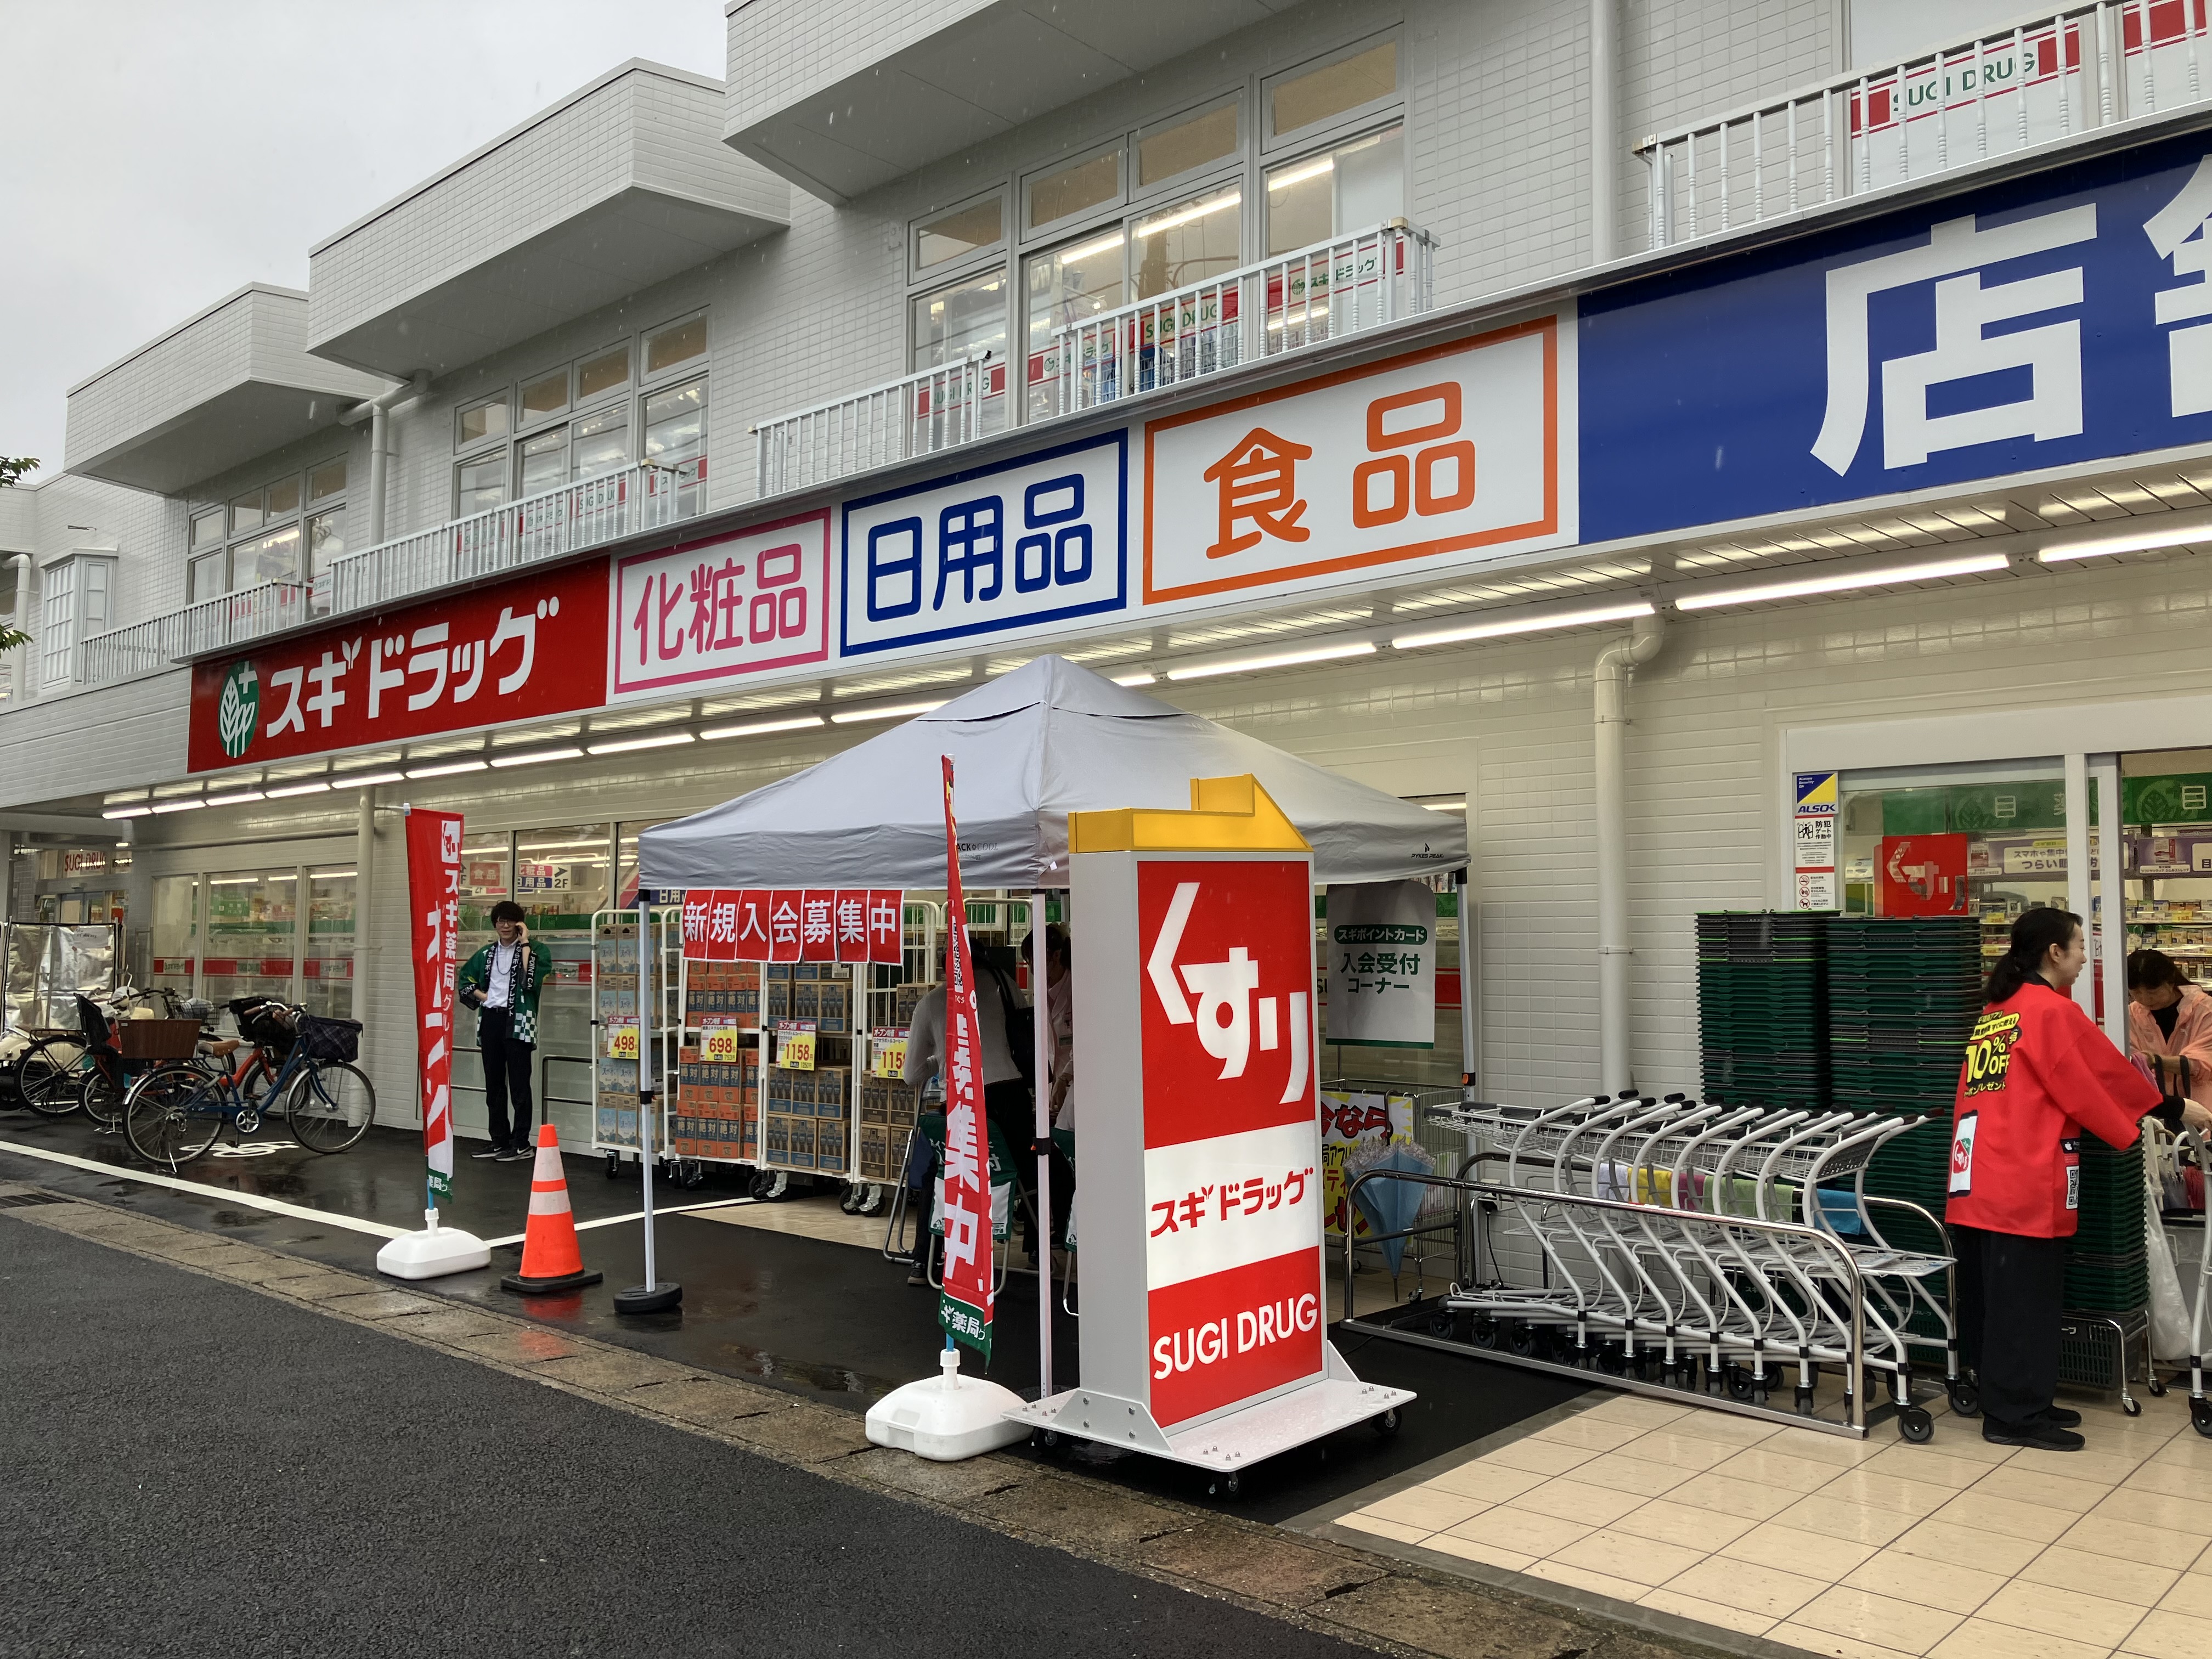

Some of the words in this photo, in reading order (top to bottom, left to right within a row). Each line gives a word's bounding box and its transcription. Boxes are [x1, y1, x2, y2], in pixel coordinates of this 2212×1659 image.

[1203, 381, 1475, 560] 食品
[867, 473, 1092, 622] 日用品
[634, 543, 807, 665] 化粧品
[266, 596, 559, 738] スギドラッグ
[1797, 804, 1836, 813] ALSOK
[554, 878, 569, 888] 2F
[659, 889, 687, 904] 日用
[684, 899, 896, 944] 新規入会募集中
[1338, 926, 1425, 943] スギポイントカード
[1340, 952, 1421, 975] 入会受付
[460, 984, 476, 997] POINT
[1147, 882, 1308, 1105] くすり
[1347, 977, 1409, 994] コーナー
[1989, 1054, 2011, 1075] OFF
[1150, 1166, 1314, 1238] スギドラッグ
[1153, 1326, 1228, 1381] SUGI
[1238, 1292, 1318, 1355] DRUG
